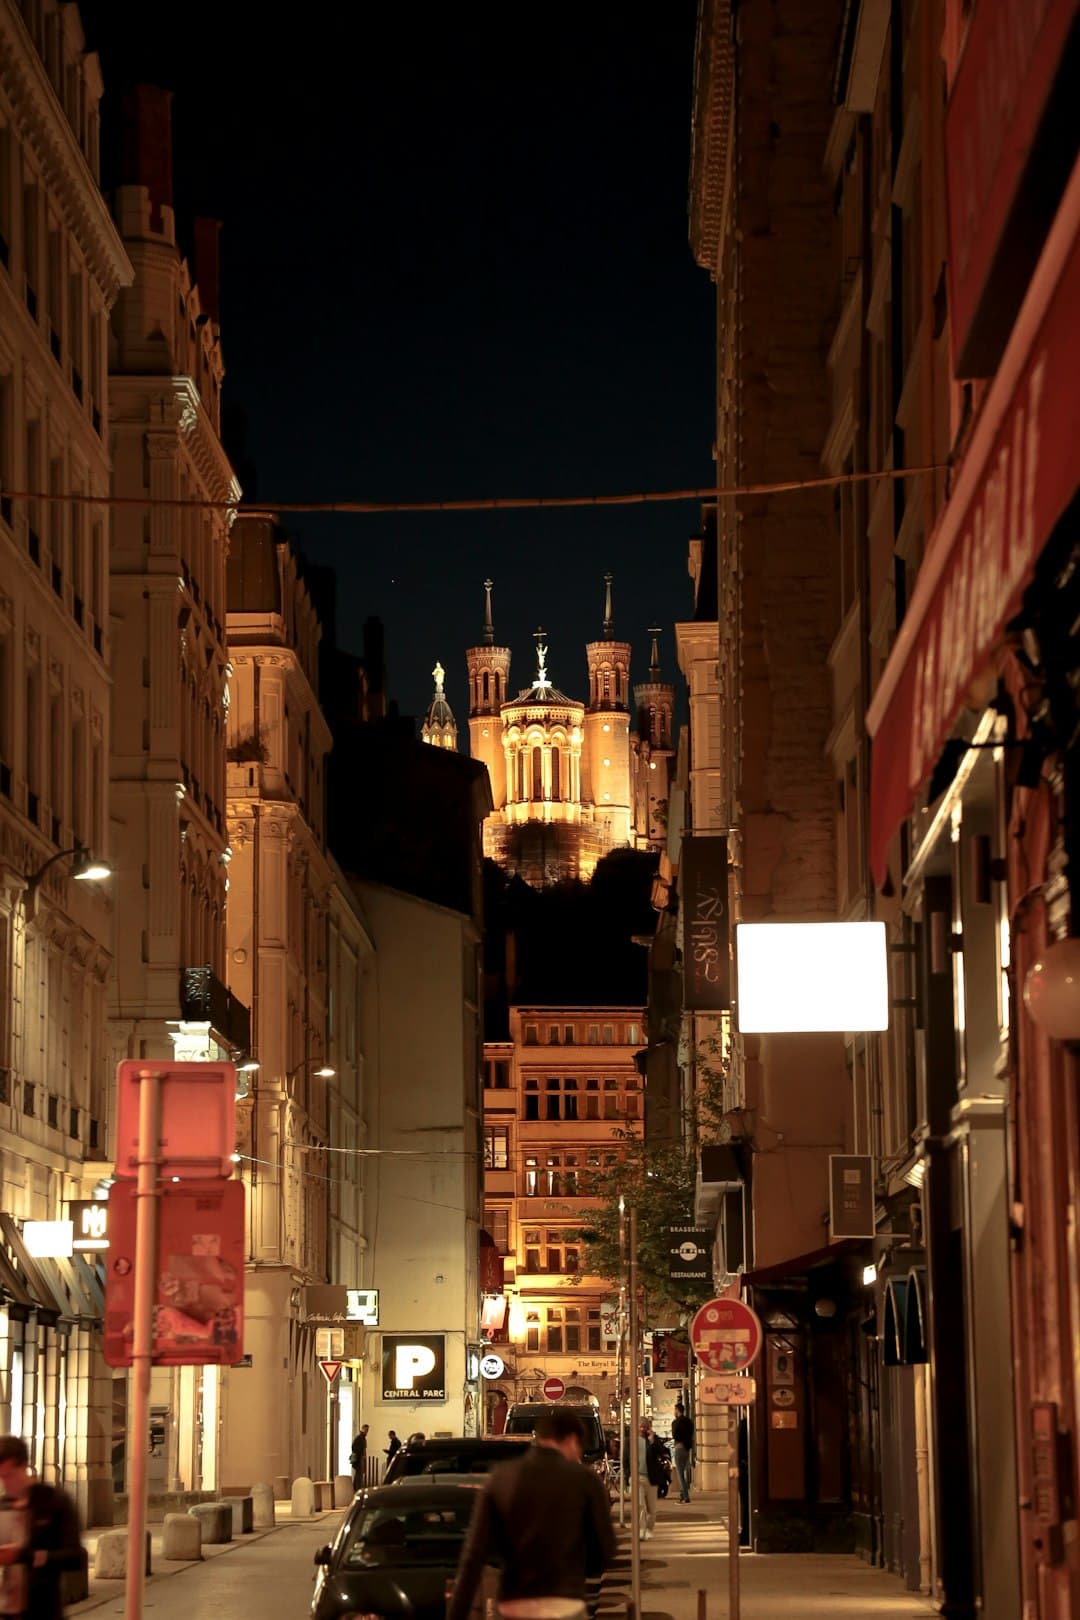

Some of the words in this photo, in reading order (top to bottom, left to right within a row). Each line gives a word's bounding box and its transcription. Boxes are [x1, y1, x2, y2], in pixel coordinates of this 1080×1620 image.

[395, 1345, 436, 1390] P
[383, 1389, 420, 1398] CENTRAL
[423, 1389, 444, 1398] PARC
